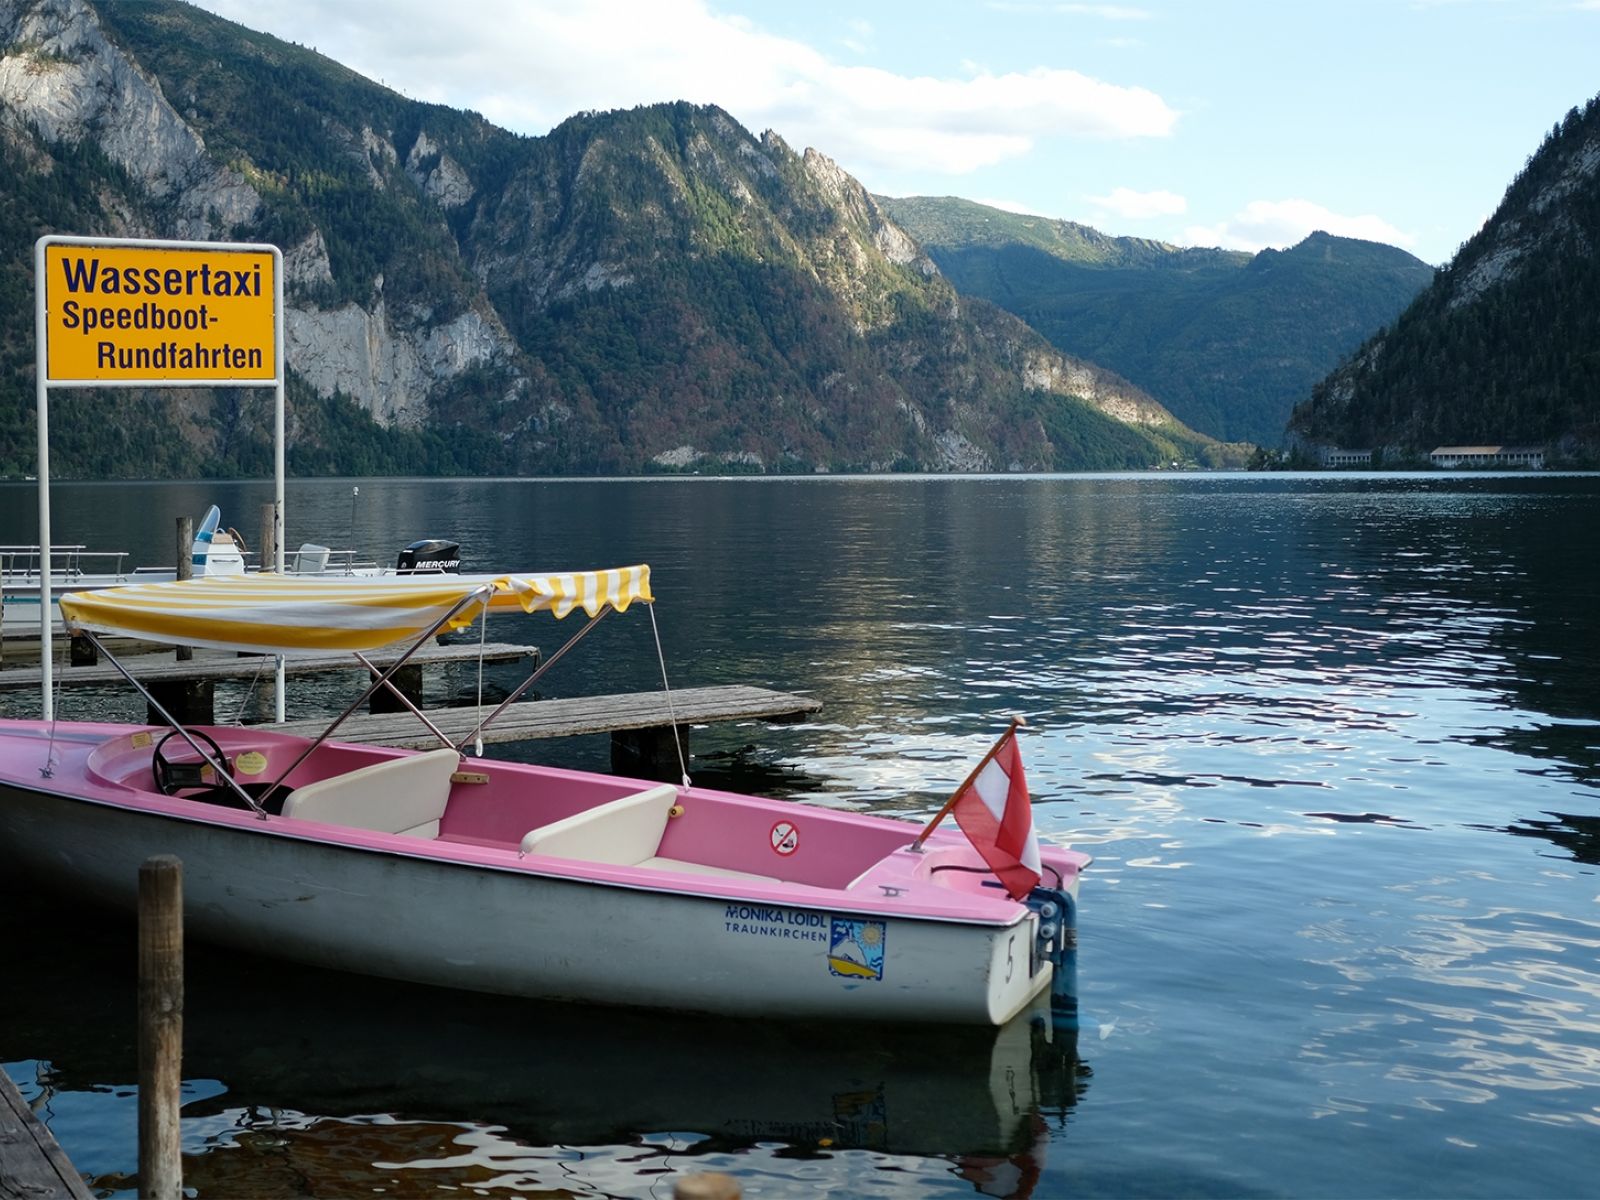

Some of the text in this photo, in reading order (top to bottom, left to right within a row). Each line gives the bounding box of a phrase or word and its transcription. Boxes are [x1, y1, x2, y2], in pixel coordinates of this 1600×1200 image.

[62, 258, 261, 297] Wassertaxi
[62, 300, 219, 335] Speedboot-
[97, 341, 263, 369] Rundfahrten
[415, 560, 460, 569] MERCURY
[725, 906, 827, 928] MONIKA LOIDL
[725, 922, 827, 942] TRAUNKIRCHEN
